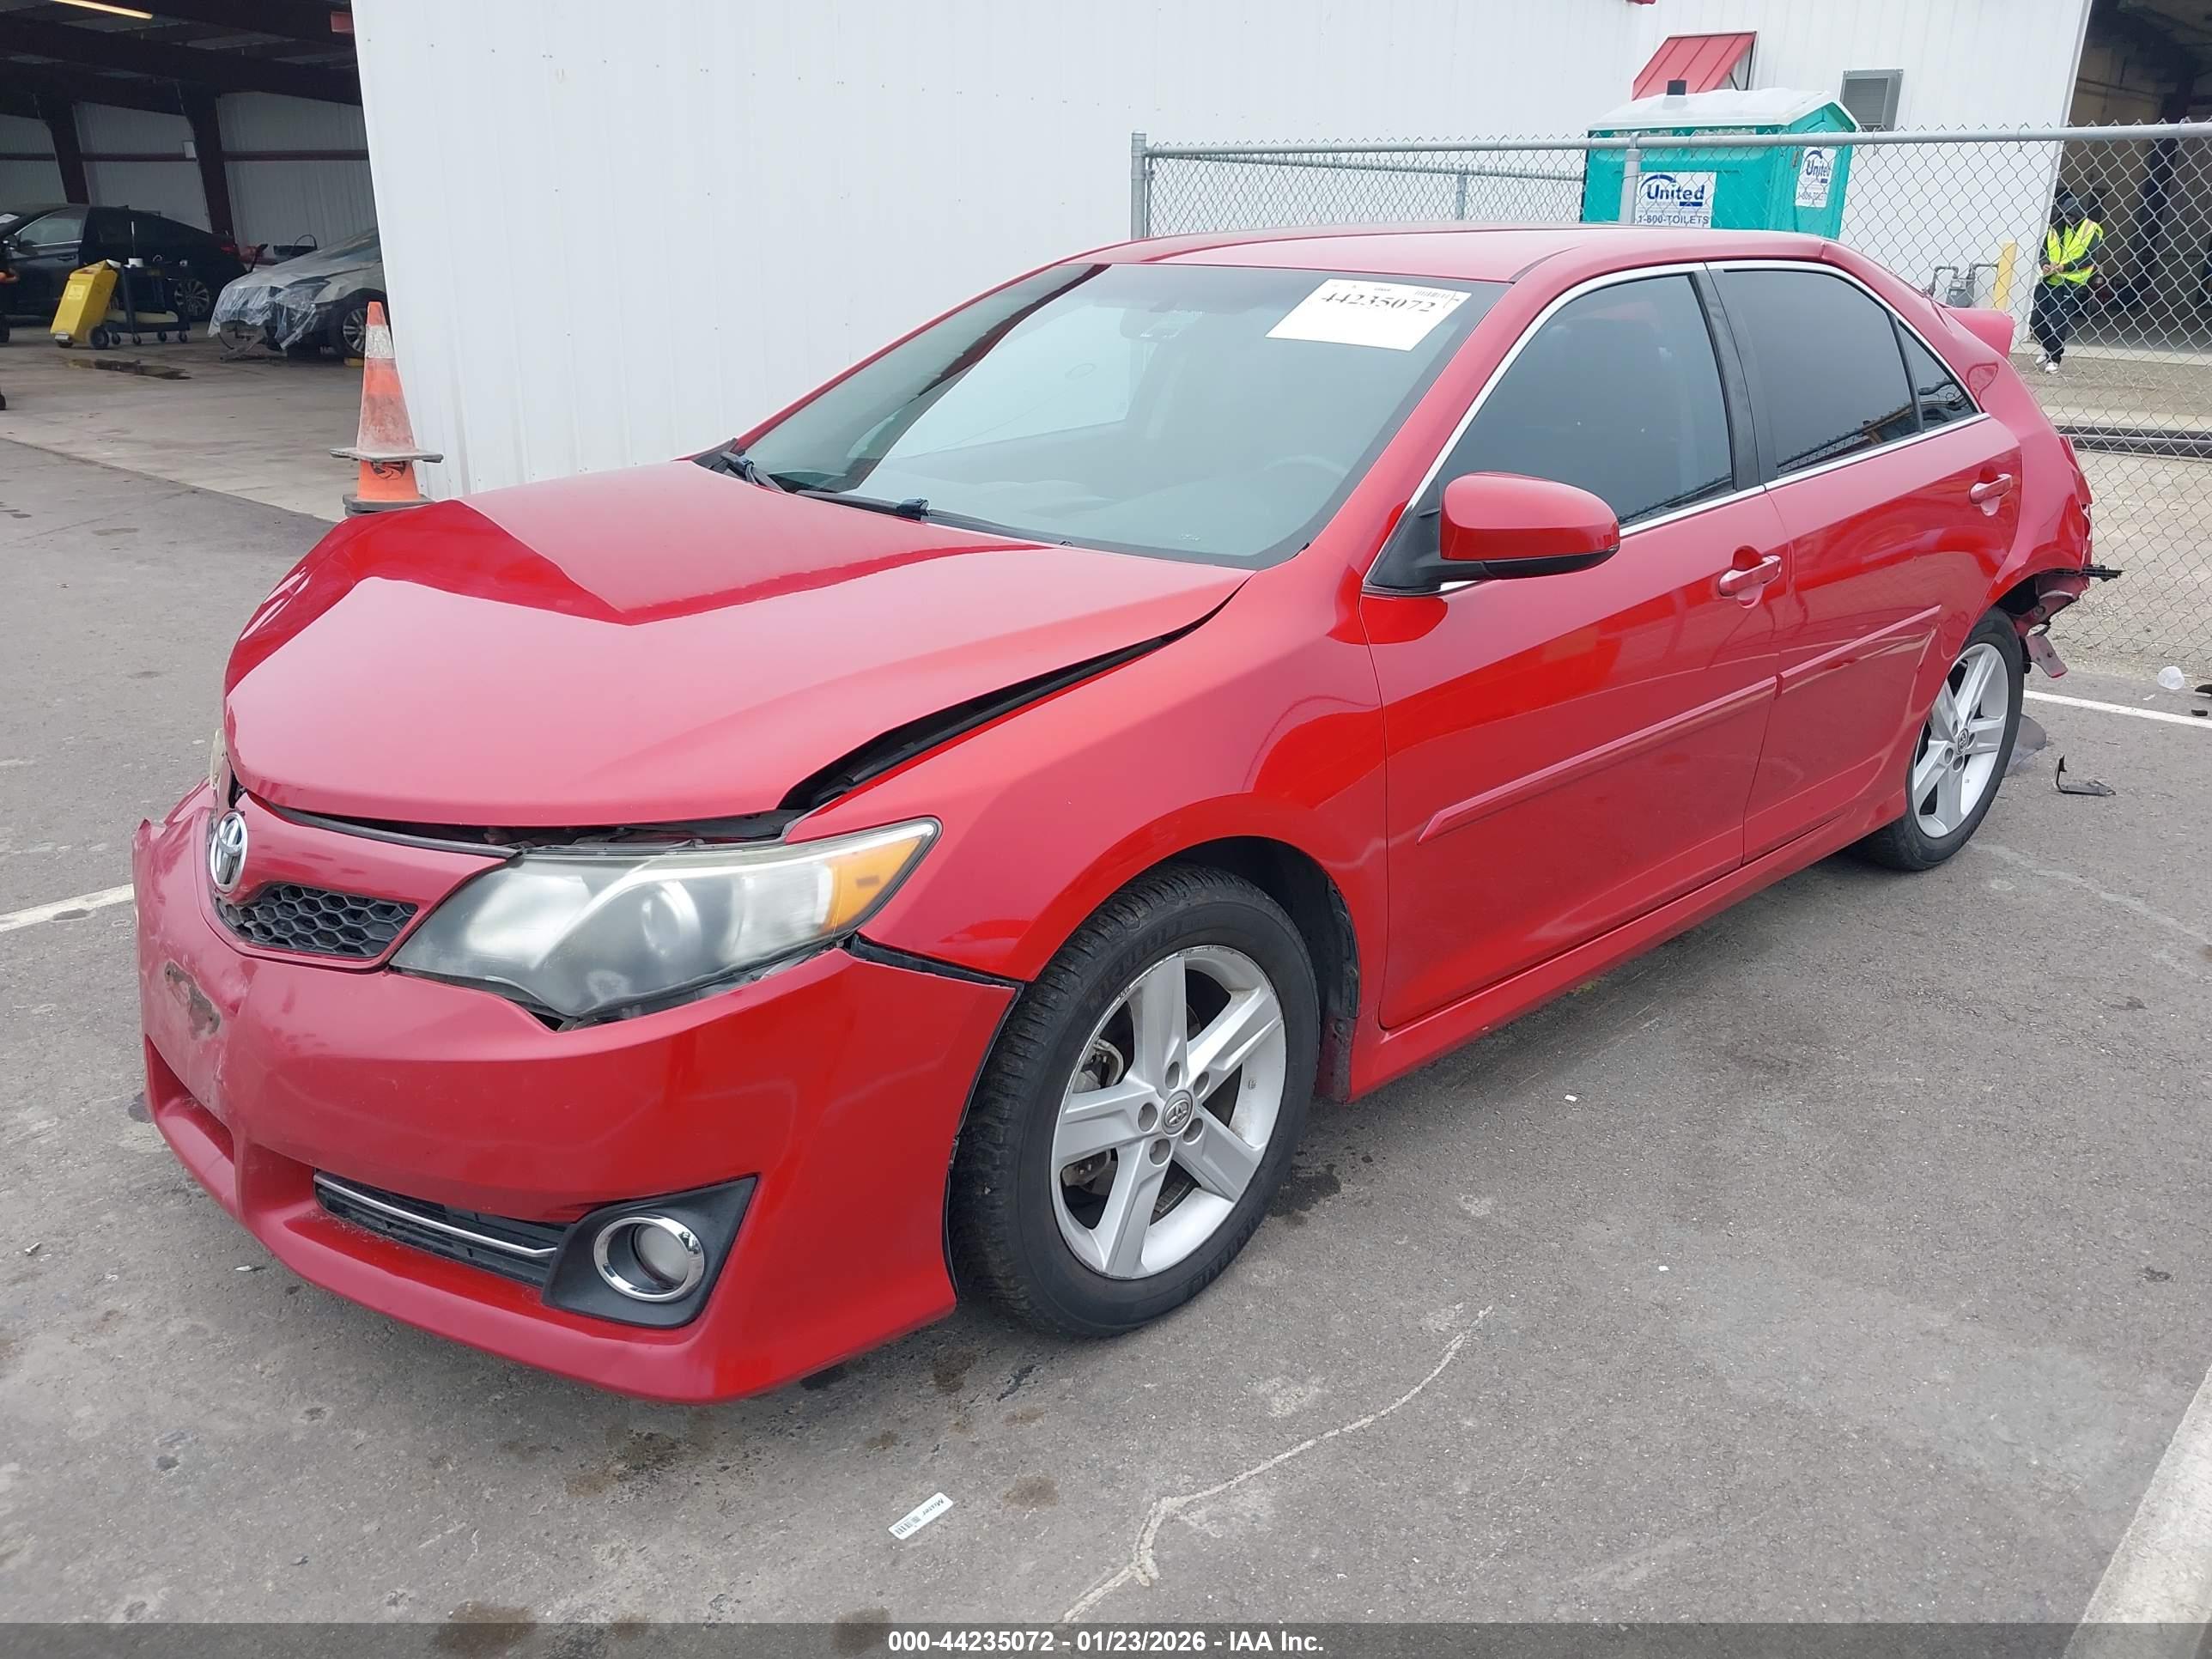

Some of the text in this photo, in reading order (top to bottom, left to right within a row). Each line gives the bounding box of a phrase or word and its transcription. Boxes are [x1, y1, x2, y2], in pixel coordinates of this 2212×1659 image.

[1647, 183, 1705, 200] United
[1638, 215, 1710, 225] 1-800-TOILETS
[1322, 293, 1436, 312] 44235072
